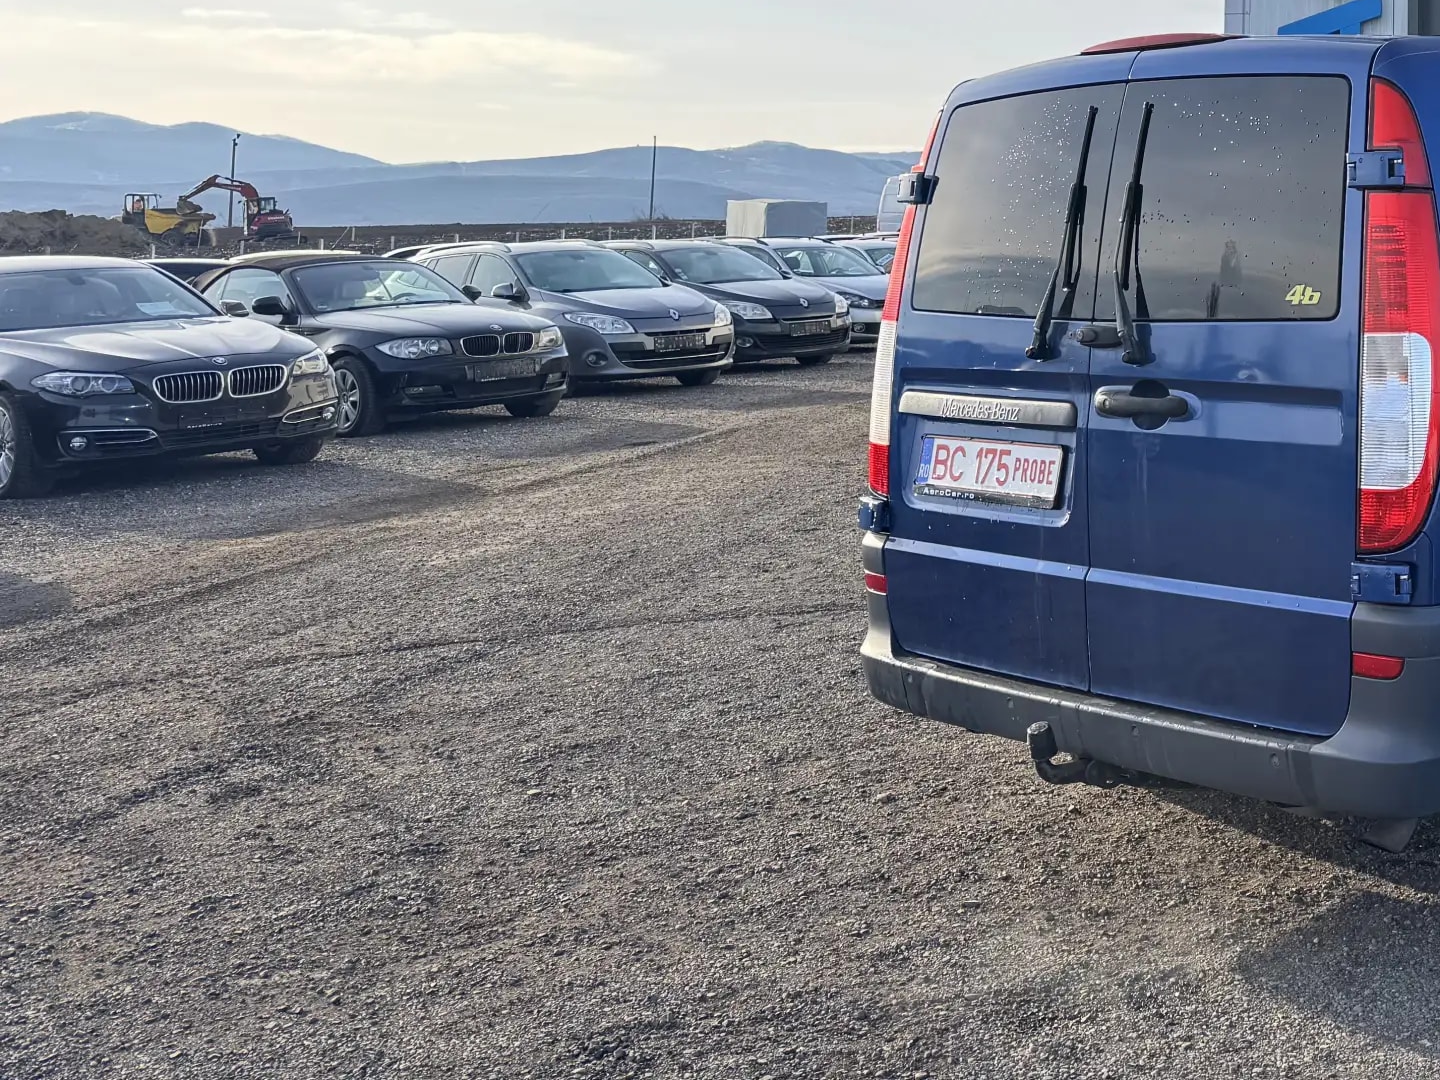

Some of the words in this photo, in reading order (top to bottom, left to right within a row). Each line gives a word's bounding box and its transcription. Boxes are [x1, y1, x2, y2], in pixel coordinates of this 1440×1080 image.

[940, 398, 1020, 420] Mercedes-Benz
[918, 462, 930, 479] RO
[932, 444, 966, 482] BC
[974, 446, 1012, 487] 175
[1013, 457, 1056, 485] PROBE
